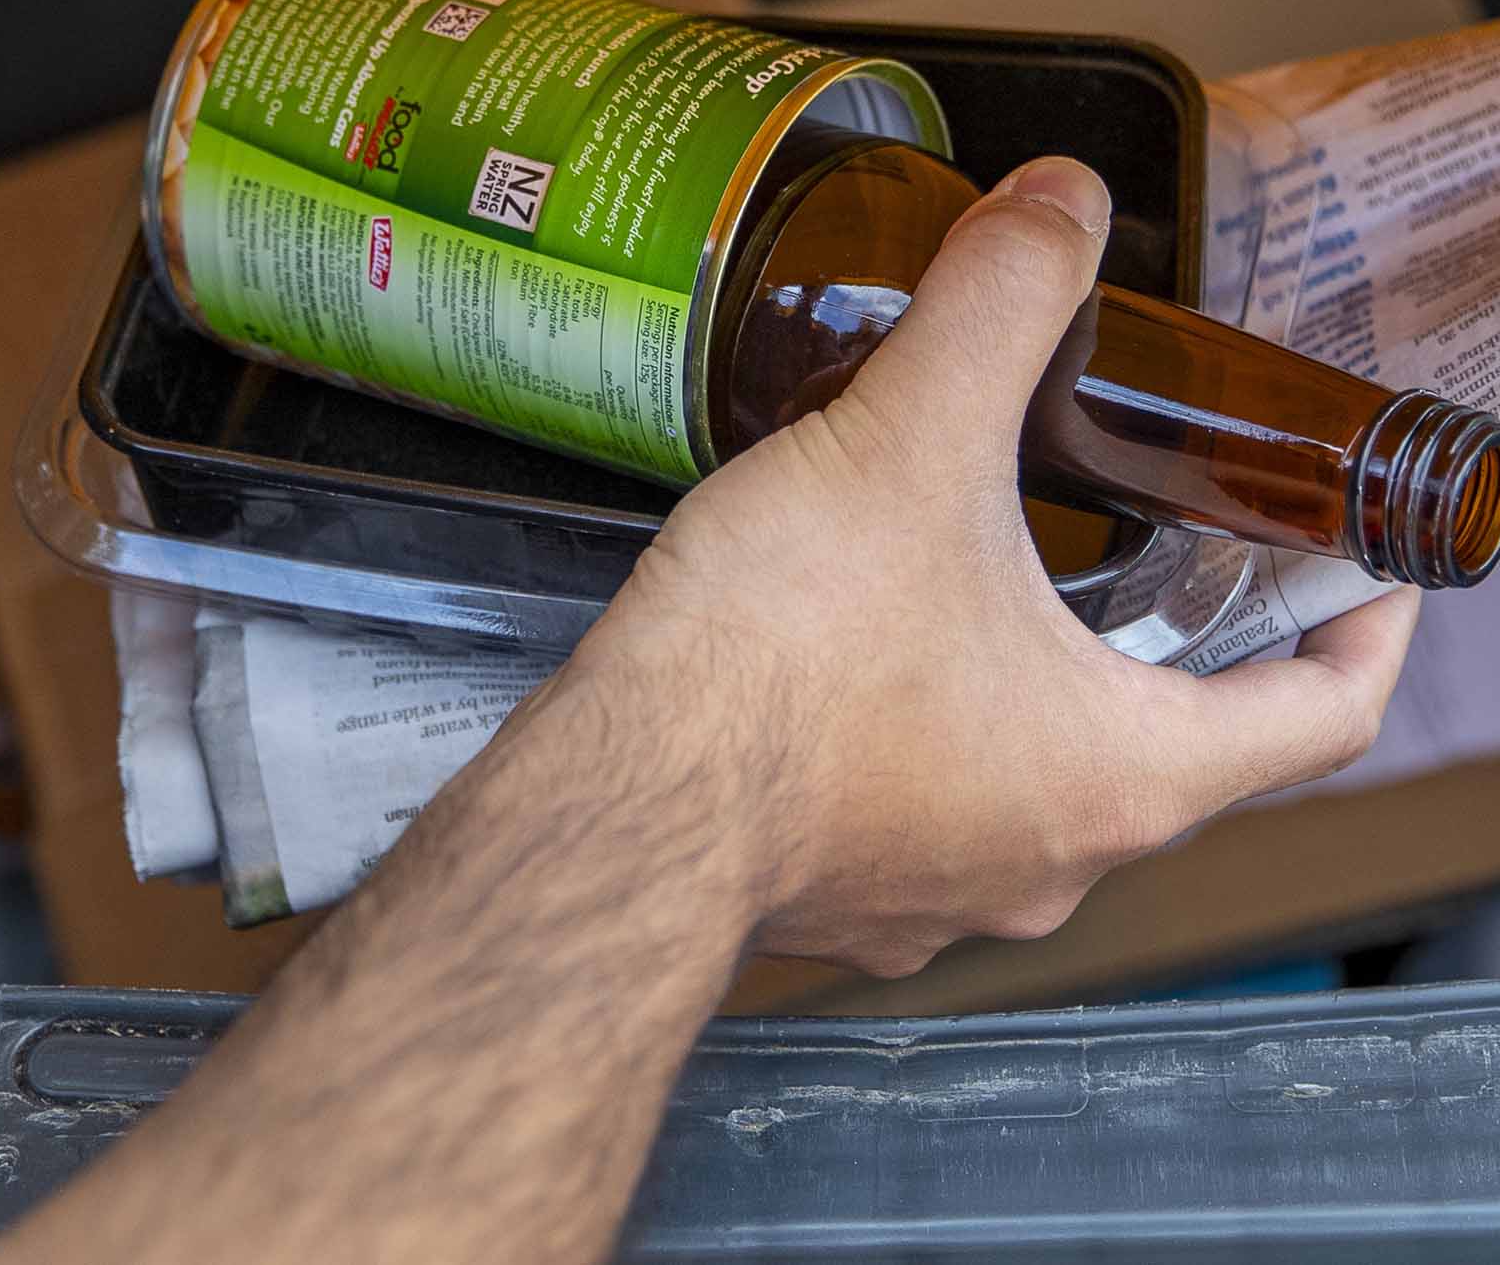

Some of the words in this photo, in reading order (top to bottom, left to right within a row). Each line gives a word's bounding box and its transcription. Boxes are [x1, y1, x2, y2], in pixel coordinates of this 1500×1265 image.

[370, 38, 389, 59] Up
[521, 50, 540, 70] are
[556, 45, 586, 79] source
[294, 63, 315, 89] the
[474, 68, 489, 82] in
[574, 48, 611, 88] punch
[624, 73, 637, 90] of
[642, 65, 678, 98] Thanks
[683, 70, 697, 82] so
[297, 59, 335, 116] keeping
[344, 59, 374, 108] About
[464, 80, 483, 99] fat
[496, 77, 521, 112] great
[611, 86, 632, 103] the
[667, 81, 692, 103] that
[695, 77, 723, 101] been
[263, 97, 284, 127] Our
[450, 99, 467, 127] and
[468, 77, 500, 125] protein,
[501, 89, 537, 138] healthy
[634, 98, 650, 109] to
[654, 102, 675, 119] the
[328, 108, 353, 148] Cans
[619, 110, 641, 132] this
[638, 121, 664, 149] taste
[663, 101, 700, 145] selecting
[374, 102, 423, 175] food
[610, 132, 624, 149] we
[570, 142, 599, 177] today.
[599, 150, 617, 173] can
[627, 149, 643, 174] and
[654, 148, 676, 166] the
[475, 160, 501, 211] WATER
[487, 161, 512, 213] SPRING
[498, 164, 545, 225] NZ
[589, 175, 608, 204] still
[639, 168, 666, 207] finest
[604, 173, 629, 232] goodness
[573, 202, 595, 237] enjoy
[622, 203, 644, 258] produce
[599, 233, 612, 246] is
[471, 249, 484, 309] Ingredients:
[510, 259, 520, 279] Iron
[518, 263, 531, 301] Sodium
[528, 266, 541, 301] Dietary
[460, 269, 469, 305] Mineral
[539, 278, 550, 310] sugars
[573, 278, 583, 295] Fat,
[582, 281, 594, 317] Protein
[591, 284, 604, 319] Energy
[526, 303, 537, 328] Fibre
[547, 271, 562, 338] Carbohydrate
[558, 284, 570, 331] saturated
[570, 298, 580, 322] total
[641, 300, 656, 337] Serving
[1457, 304, 1496, 332] than
[651, 302, 667, 344] Servings
[663, 307, 679, 359] Nutrition
[641, 340, 649, 359] size:
[603, 370, 612, 386] per
[639, 363, 650, 383] 125g
[649, 365, 661, 405] package:
[1432, 360, 1455, 380] up
[1442, 351, 1497, 391] sitting
[663, 362, 674, 422] information
[1207, 615, 1279, 663] Zealand
[392, 703, 436, 726] wide
[440, 702, 452, 714] a
[457, 697, 477, 715] by
[335, 711, 387, 734] range
[419, 718, 472, 741] water
